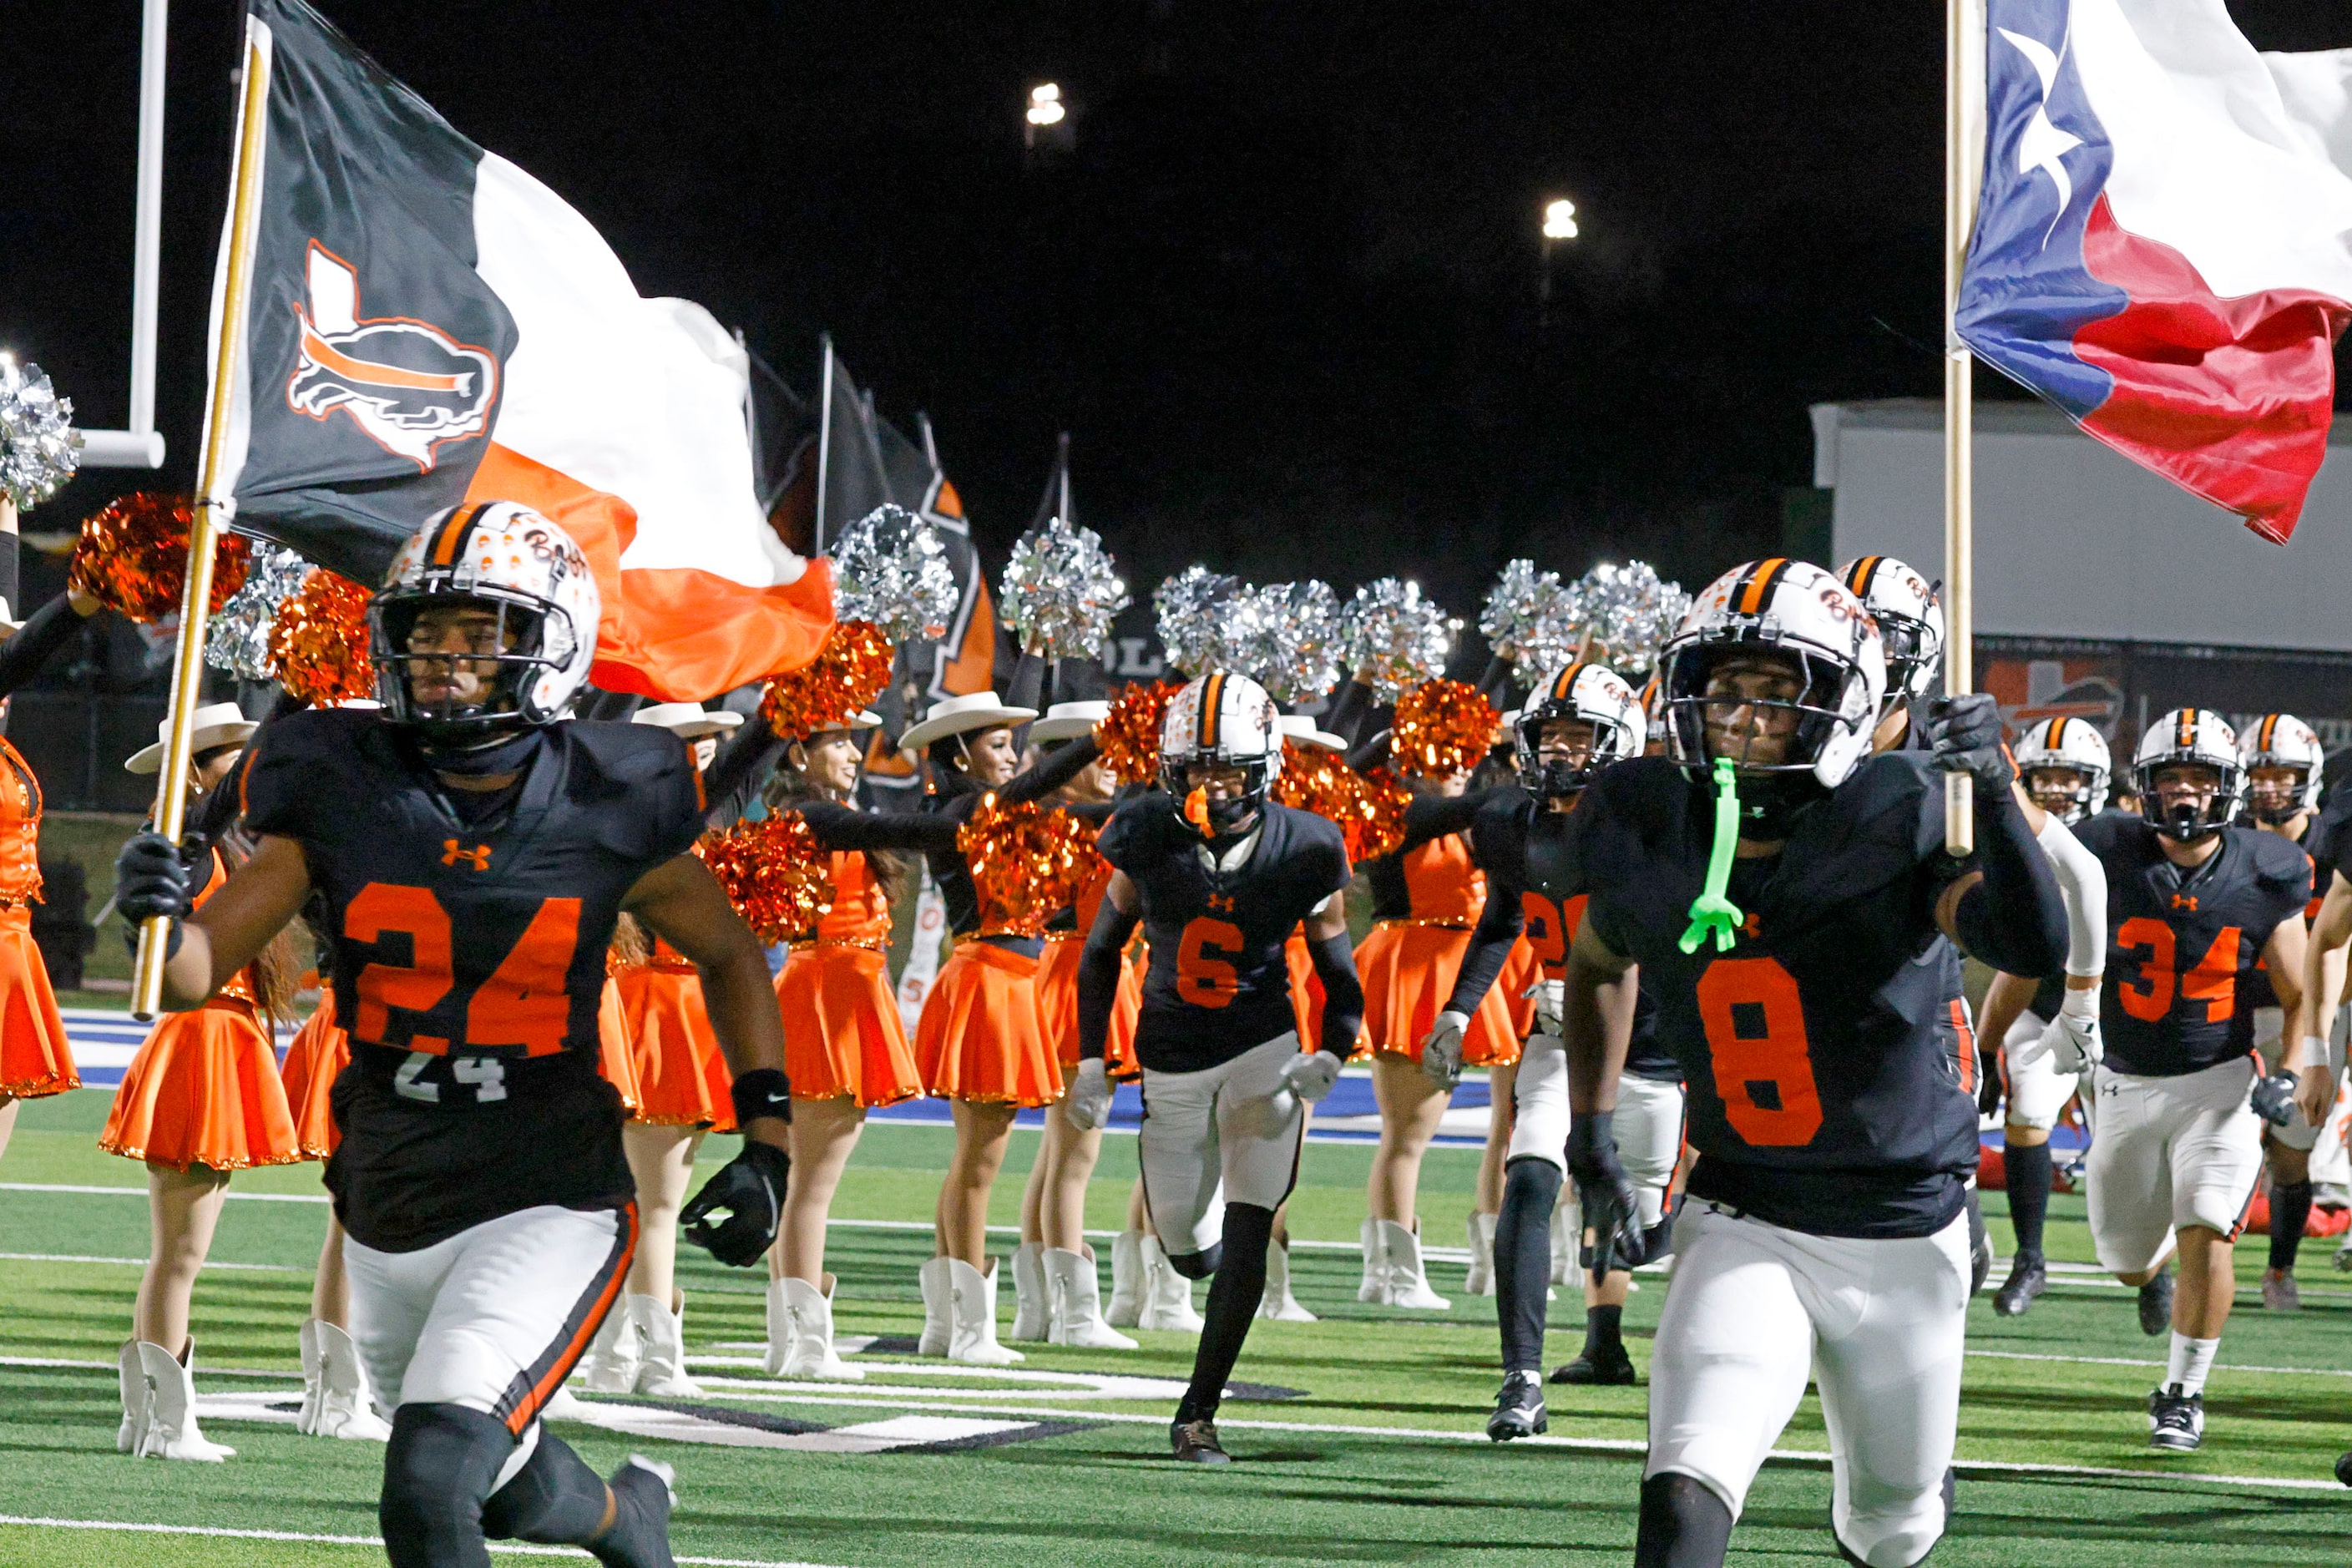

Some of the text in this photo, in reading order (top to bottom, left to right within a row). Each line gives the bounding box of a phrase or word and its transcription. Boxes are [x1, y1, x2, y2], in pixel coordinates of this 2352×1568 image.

[344, 882, 584, 1057] 24
[1176, 915, 1244, 1009] 6
[2117, 916, 2242, 1024] 34
[1696, 957, 1824, 1146] 8
